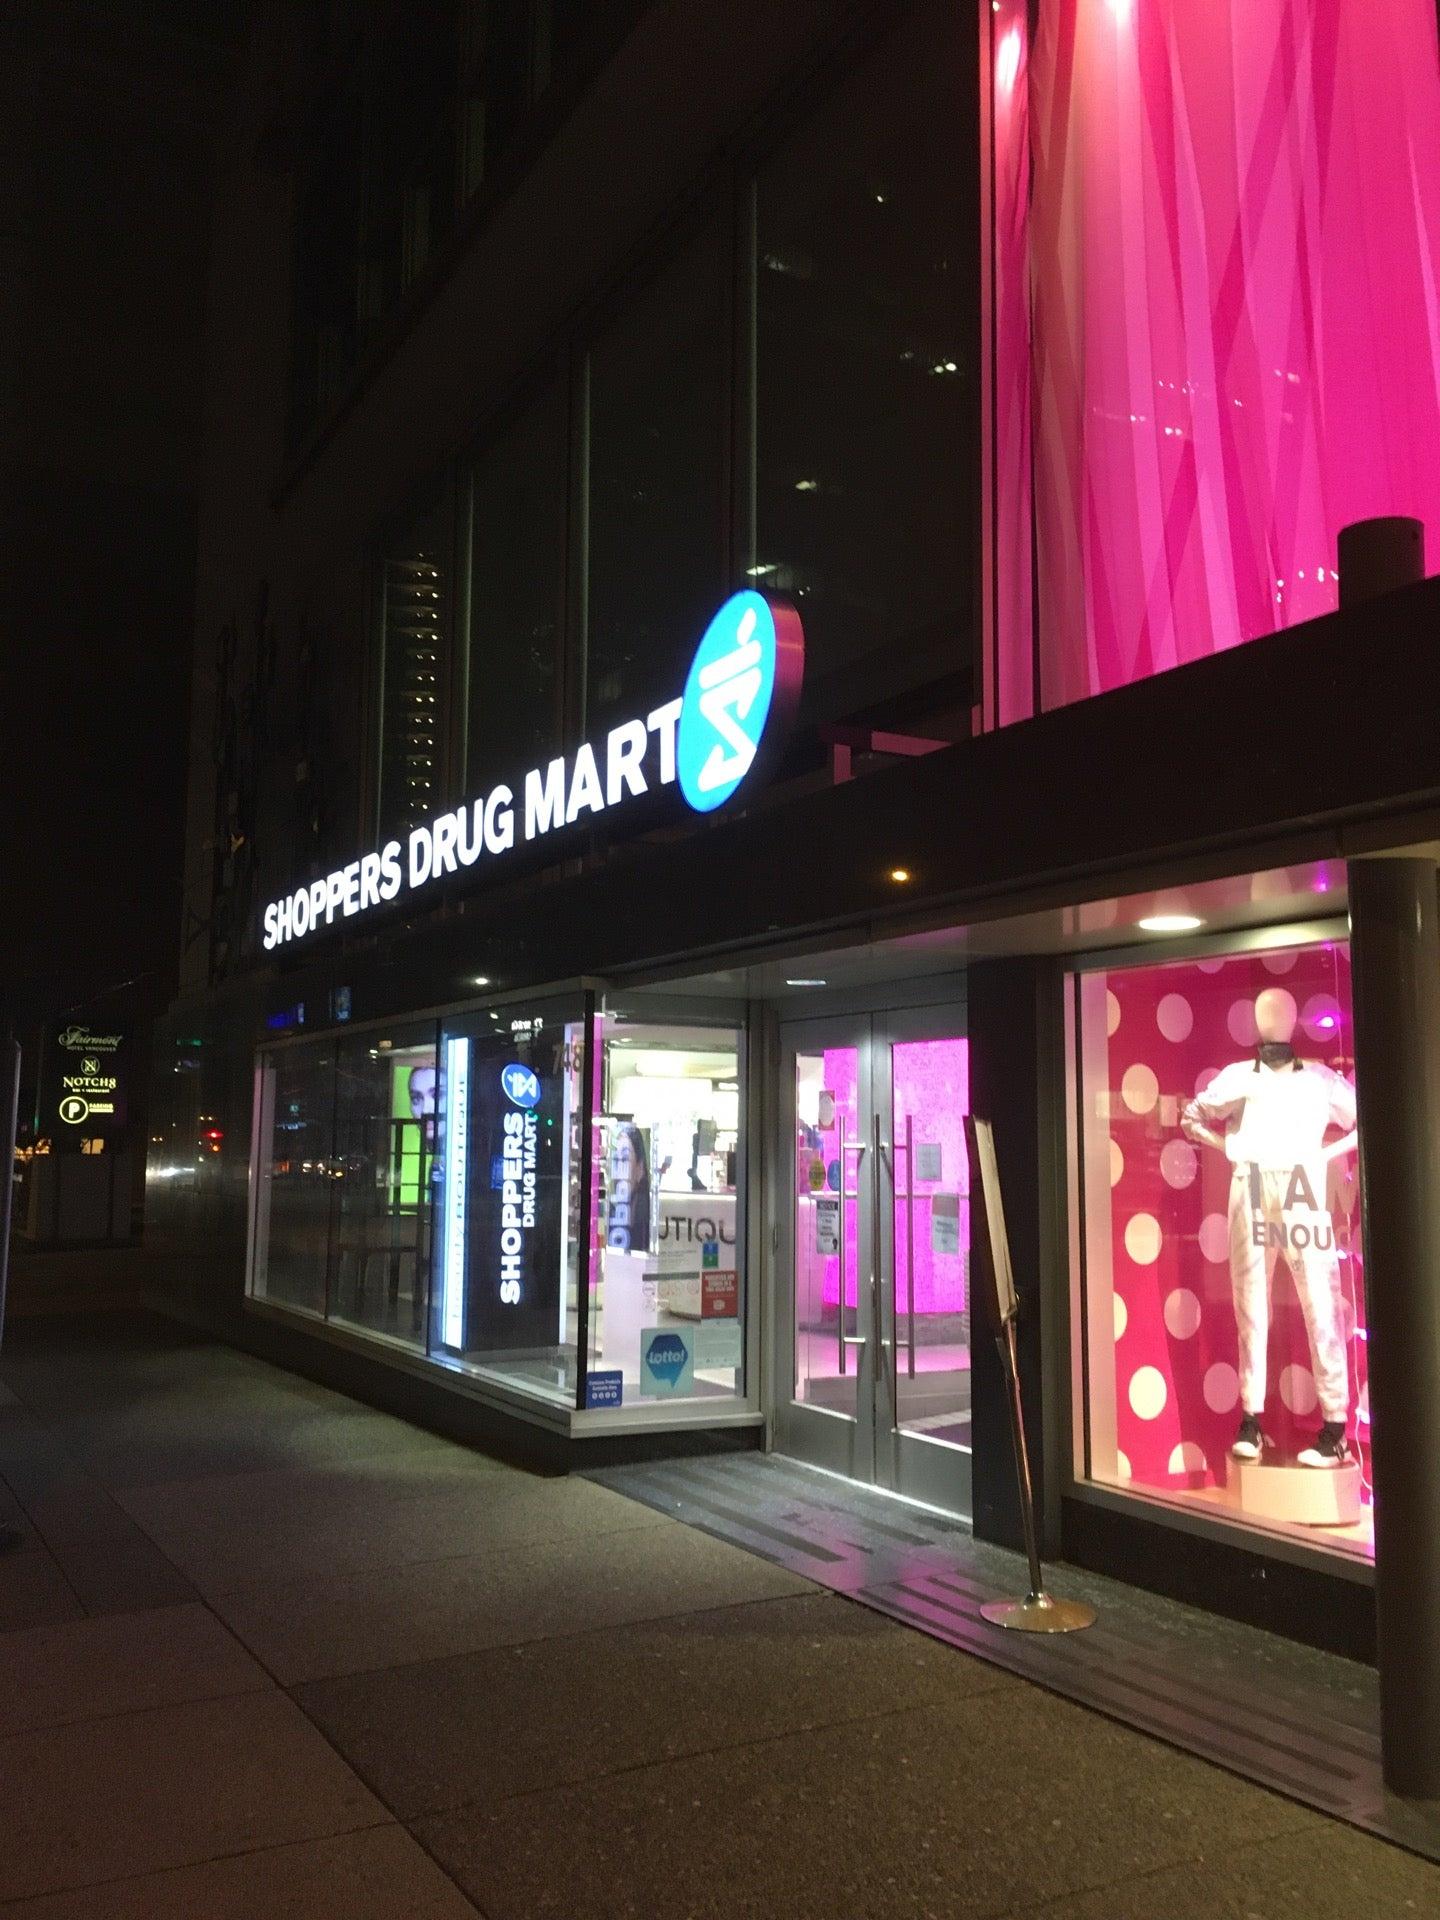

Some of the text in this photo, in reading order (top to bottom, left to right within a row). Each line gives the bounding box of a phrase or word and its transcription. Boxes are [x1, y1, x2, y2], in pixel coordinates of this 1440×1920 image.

[263, 695, 685, 950] SHOPPERS DRUG MART
[58, 1026, 123, 1047] Fairmont
[63, 1076, 117, 1089] NOTCH8
[500, 1111, 524, 1305] SHOPPERS
[522, 1113, 538, 1228] DRUG MART
[1248, 1161, 1262, 1210] I
